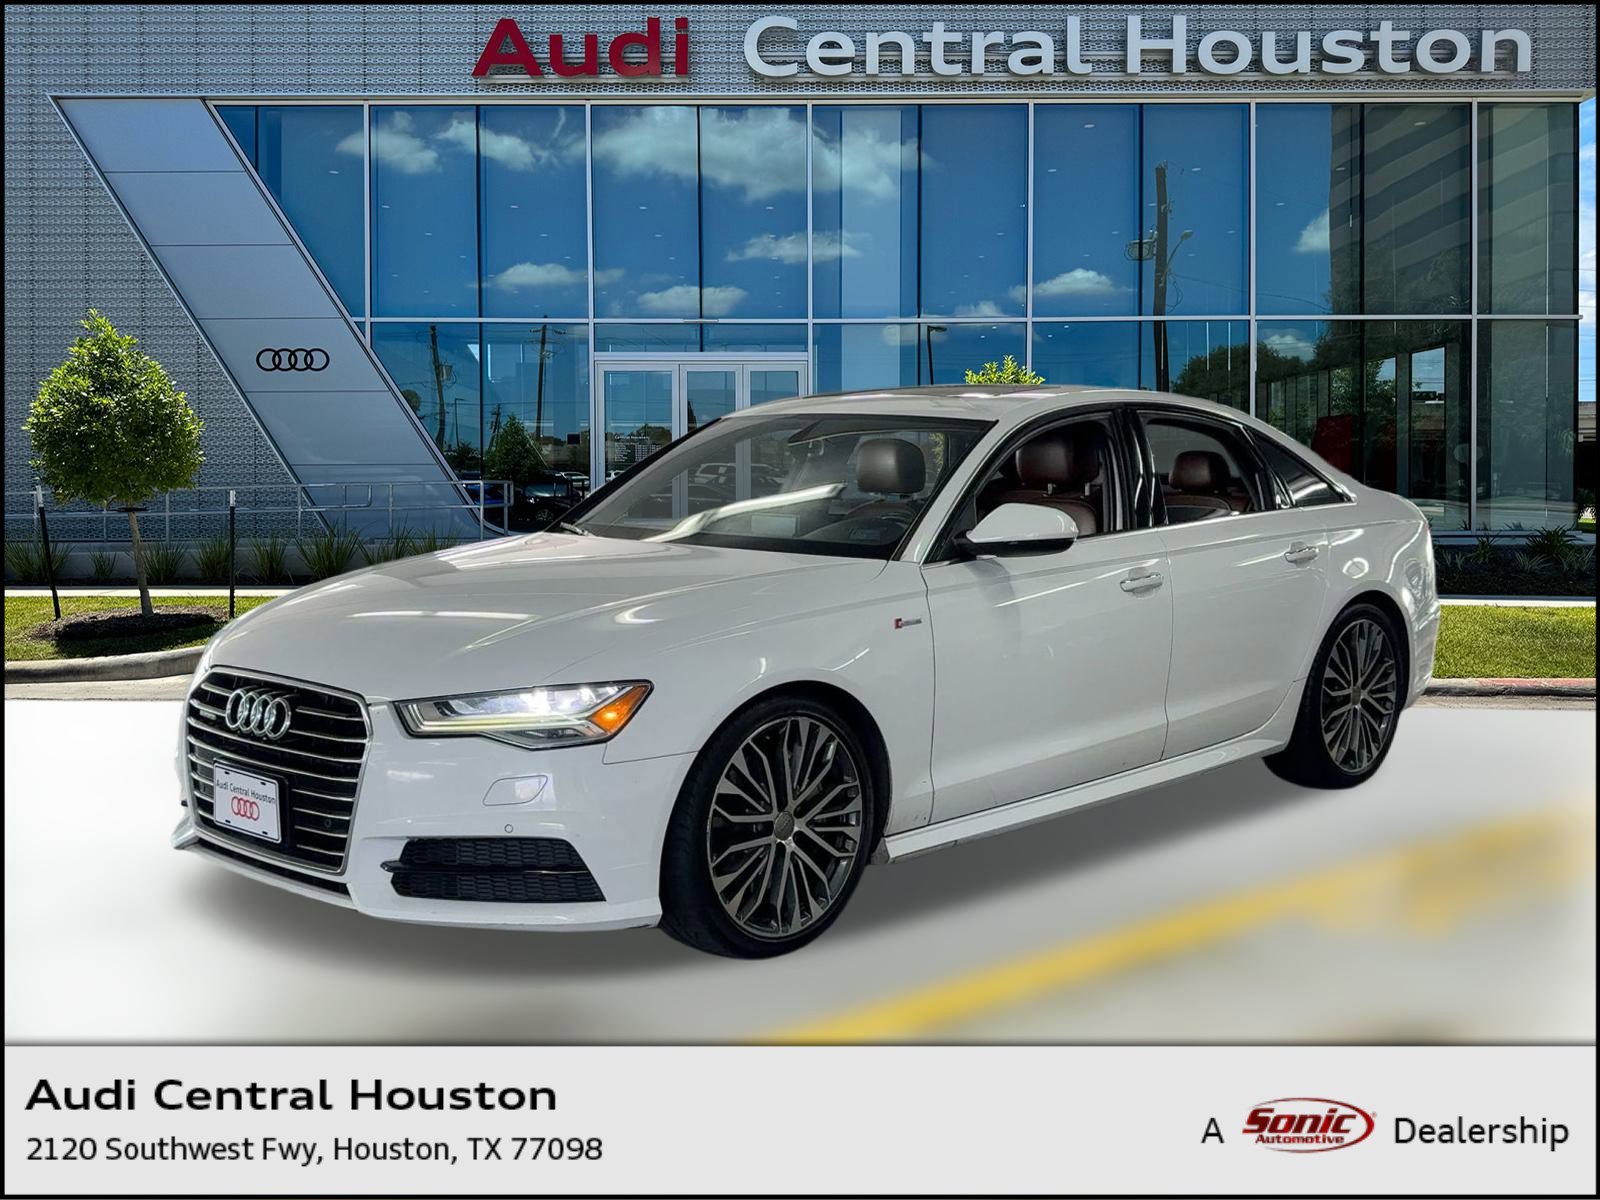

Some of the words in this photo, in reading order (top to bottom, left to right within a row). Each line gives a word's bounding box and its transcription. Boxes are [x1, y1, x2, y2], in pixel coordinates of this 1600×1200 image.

[472, 17, 689, 77] Audi
[743, 15, 1093, 77] Central
[1126, 15, 1532, 75] Houston
[216, 779, 229, 790] Audi
[229, 782, 250, 796] Central
[250, 789, 276, 804] Houston
